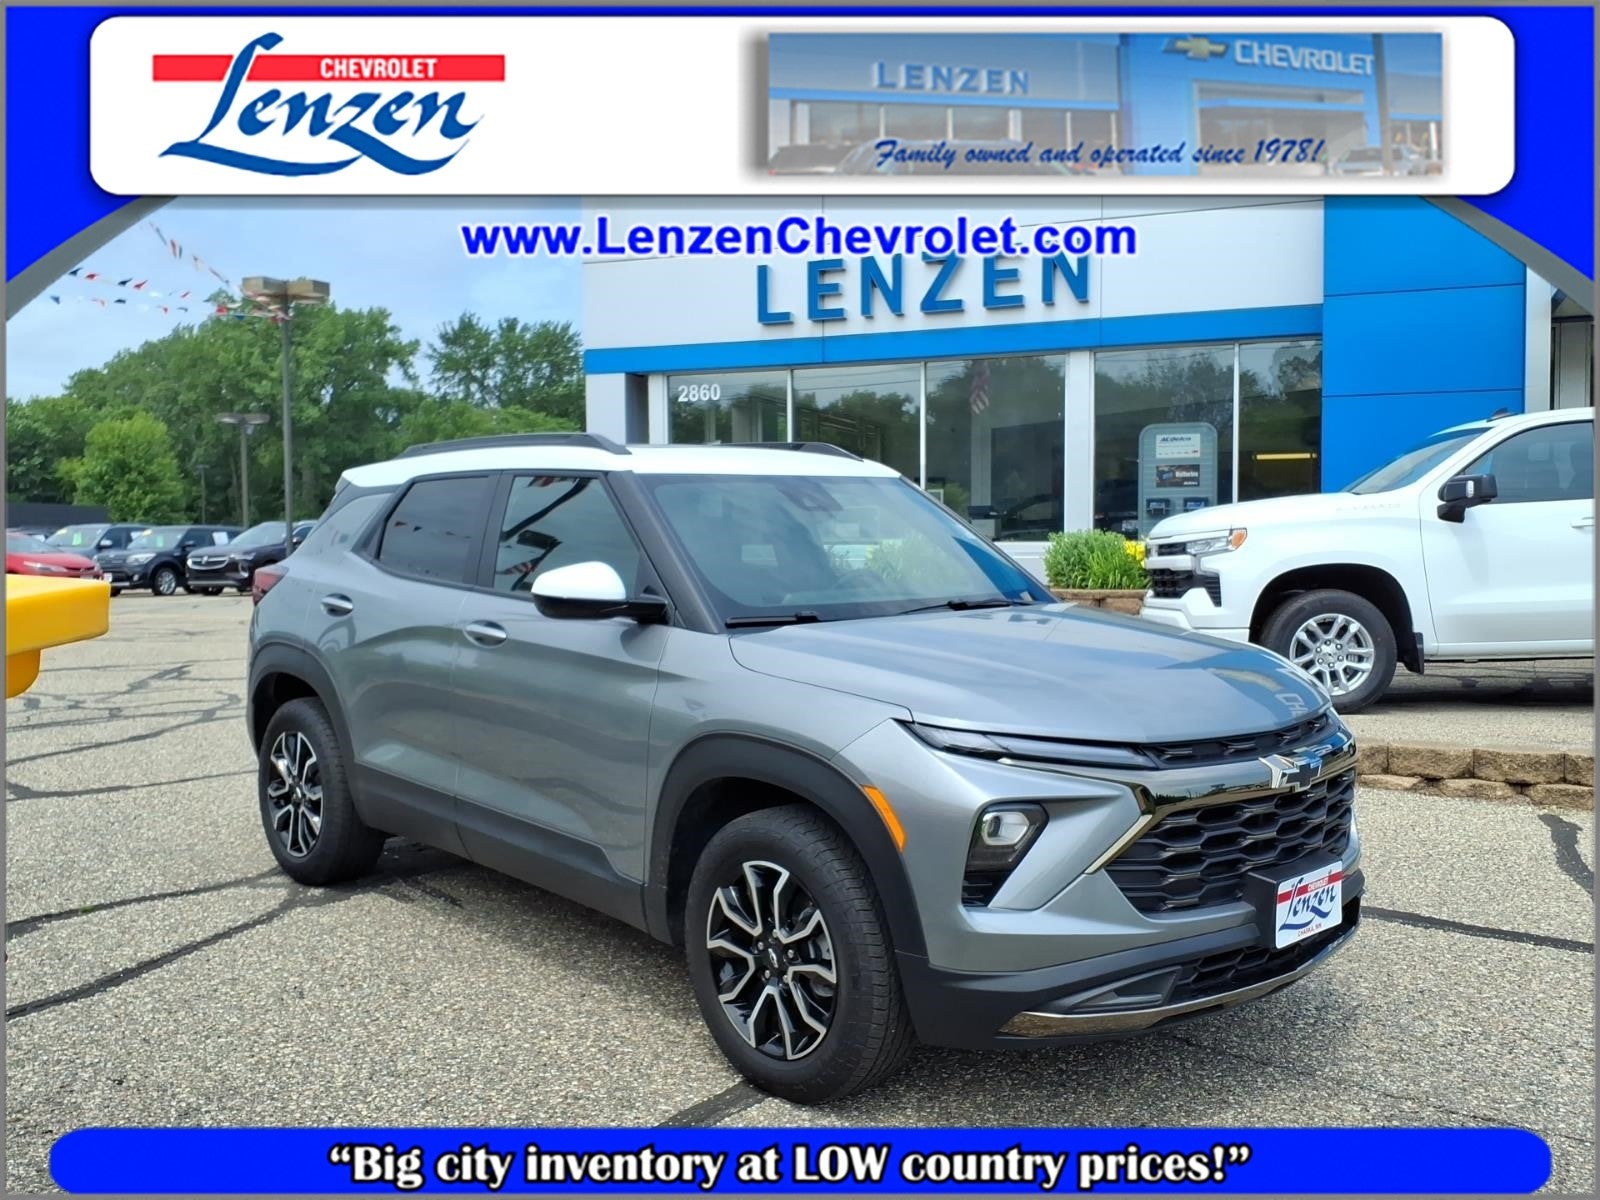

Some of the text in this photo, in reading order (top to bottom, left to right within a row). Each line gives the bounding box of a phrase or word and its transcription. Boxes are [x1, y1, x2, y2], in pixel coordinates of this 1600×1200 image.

[757, 248, 1090, 325] LENZEN
[678, 383, 721, 404] 2860
[1279, 877, 1337, 932] Lenzen
